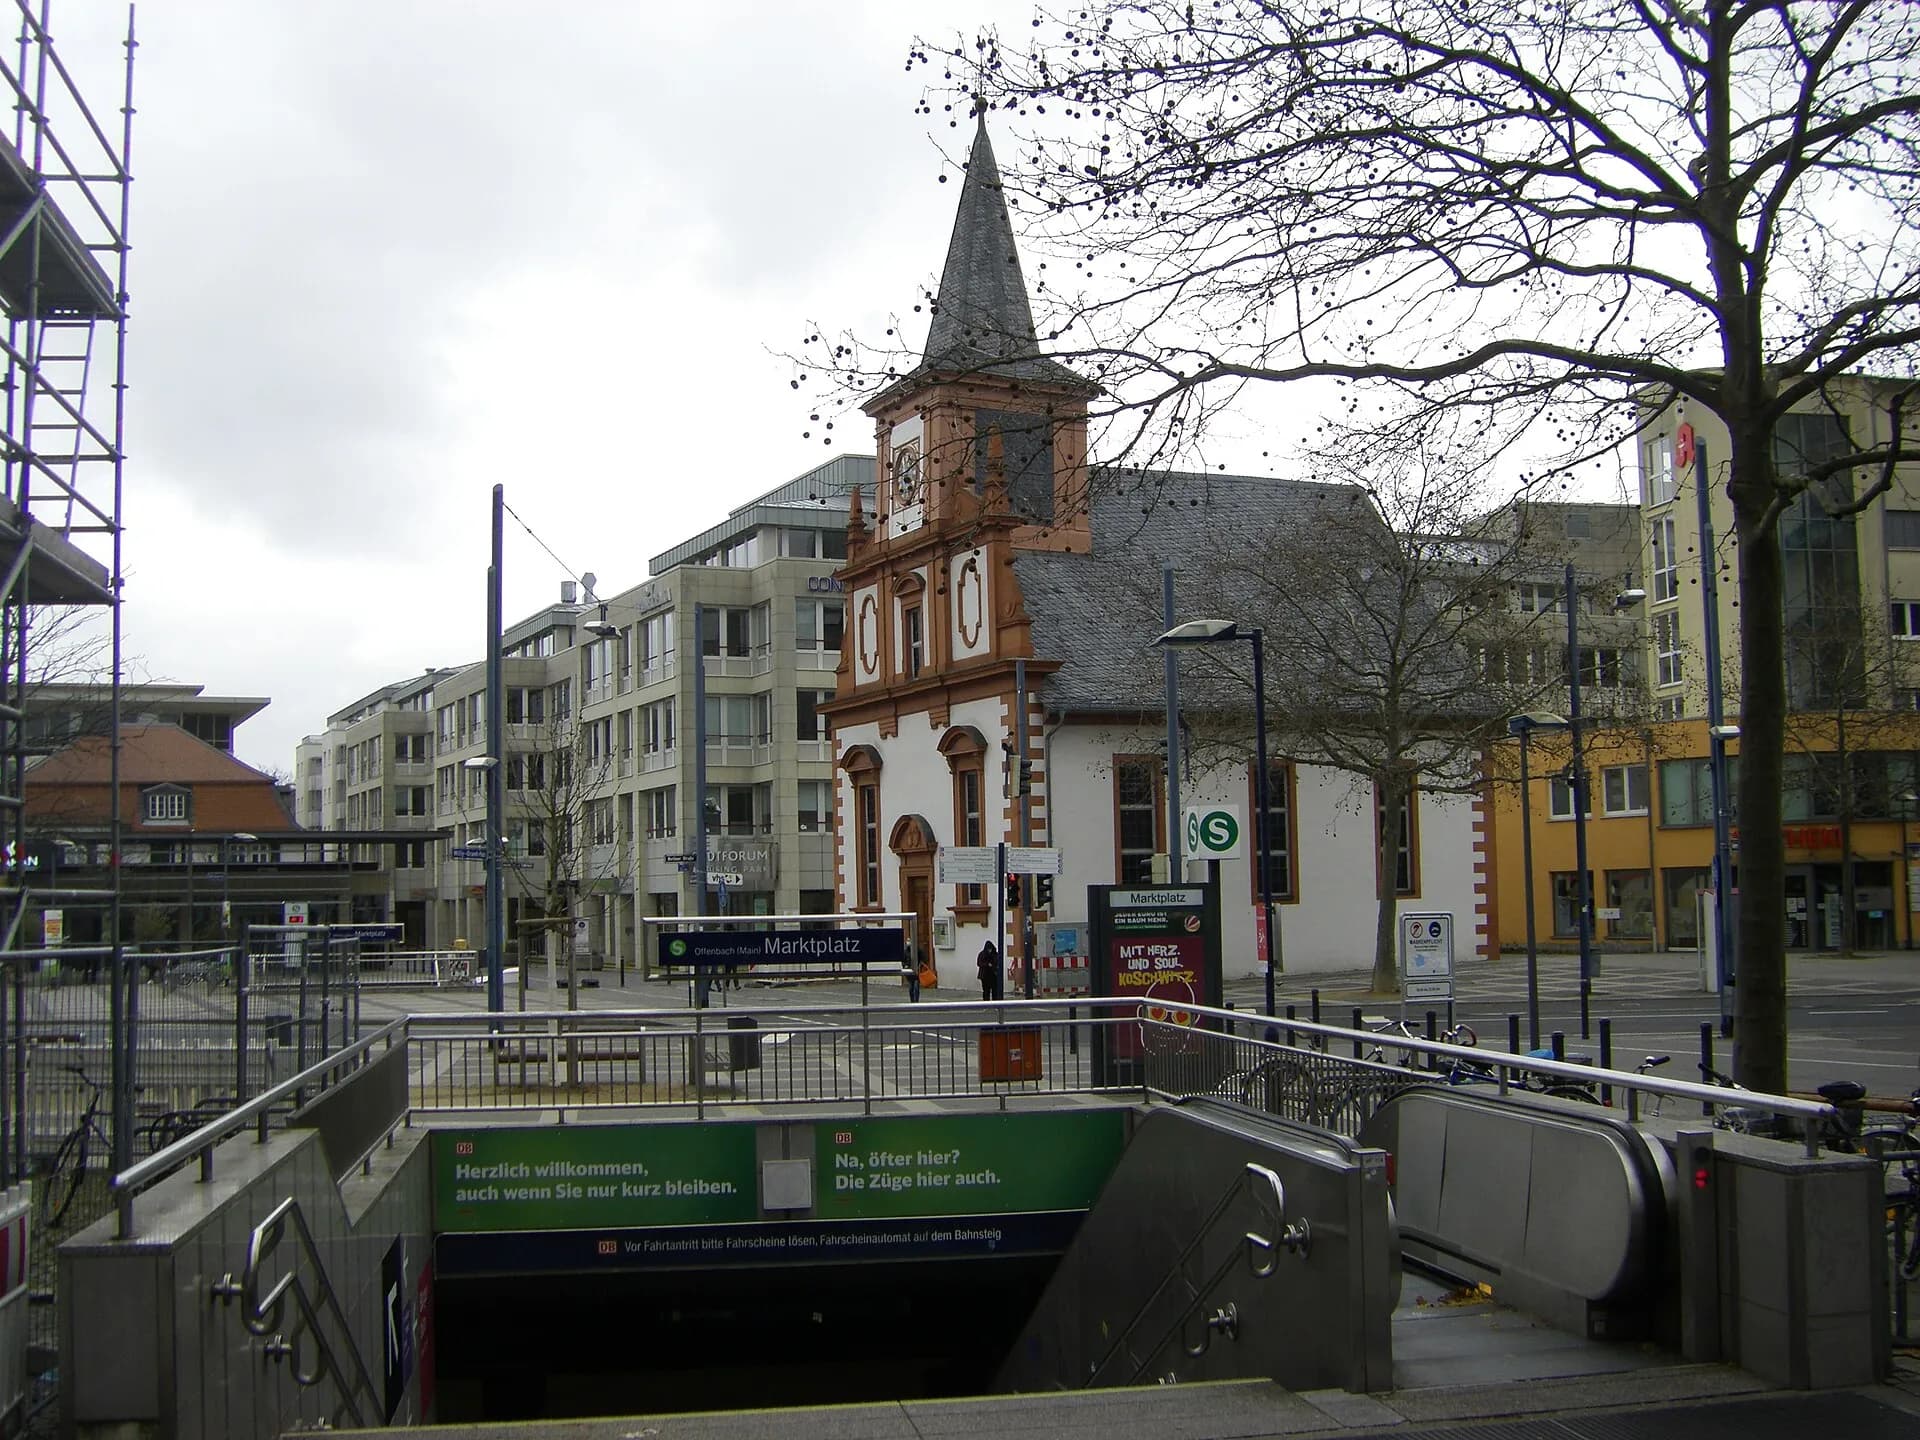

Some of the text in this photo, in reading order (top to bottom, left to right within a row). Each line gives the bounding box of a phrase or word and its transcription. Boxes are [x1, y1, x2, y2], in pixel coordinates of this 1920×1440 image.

[1208, 818, 1230, 845] S
[1130, 892, 1186, 904] Marktplatz
[694, 946, 736, 956] Offenbach
[737, 946, 762, 957] (Main)
[764, 937, 860, 957] Marktplatz
[1120, 944, 1181, 958] MIT HERZ.
[1127, 959, 1150, 970] UND
[836, 1132, 852, 1144] DB
[456, 1142, 473, 1154] DB
[835, 1149, 960, 1170] Na, öfter hier?
[455, 1160, 649, 1179] Herzlich willkommen,
[835, 1168, 1001, 1191] Die Züge hier auch.
[455, 1178, 737, 1201] auch wenn Sie nur kurz bleiben.
[599, 1227, 1001, 1254] DB Vor Fahrtantritt bitte Fahrscheine lösen, Fahrscheinautomat auf dem Bahnsteig
